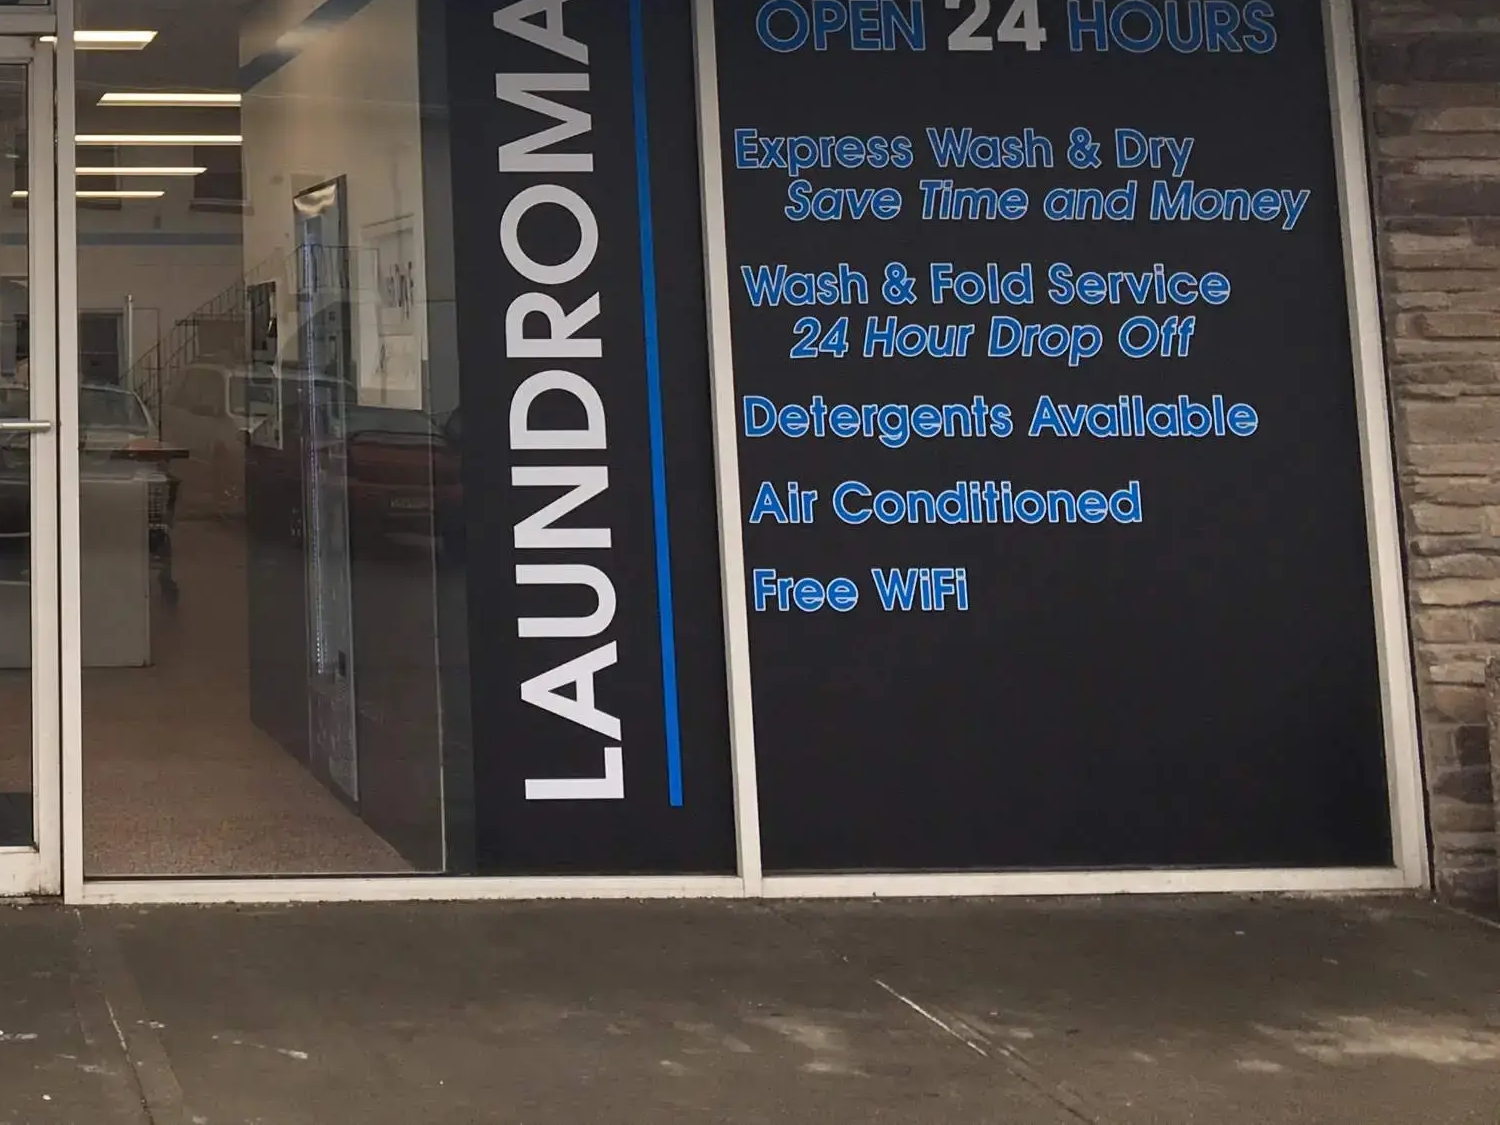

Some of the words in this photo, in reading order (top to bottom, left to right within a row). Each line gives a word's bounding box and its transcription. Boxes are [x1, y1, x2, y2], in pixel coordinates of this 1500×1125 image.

[1067, 0, 1276, 53] HOURS
[734, 128, 913, 177] Express
[926, 127, 1054, 168] Wash
[1067, 127, 1102, 169] &
[1115, 128, 1194, 177] Dry
[784, 178, 902, 221] Save
[919, 179, 1029, 220] Time
[1043, 180, 1138, 221] and
[1150, 180, 1311, 230] Money
[740, 263, 868, 307] Wash
[882, 261, 917, 305] &
[930, 263, 1034, 305] Fold
[1048, 262, 1231, 305] Service
[789, 315, 849, 359] 24
[862, 315, 975, 358] Hour
[988, 315, 1103, 367] Drop
[1118, 315, 1196, 358] Off
[743, 395, 1013, 448] Detergents
[1028, 394, 1259, 439] Available
[749, 481, 818, 523] Air
[832, 480, 1142, 524] Conditioned
[753, 568, 859, 612] Free
[871, 567, 968, 611] WiFi
